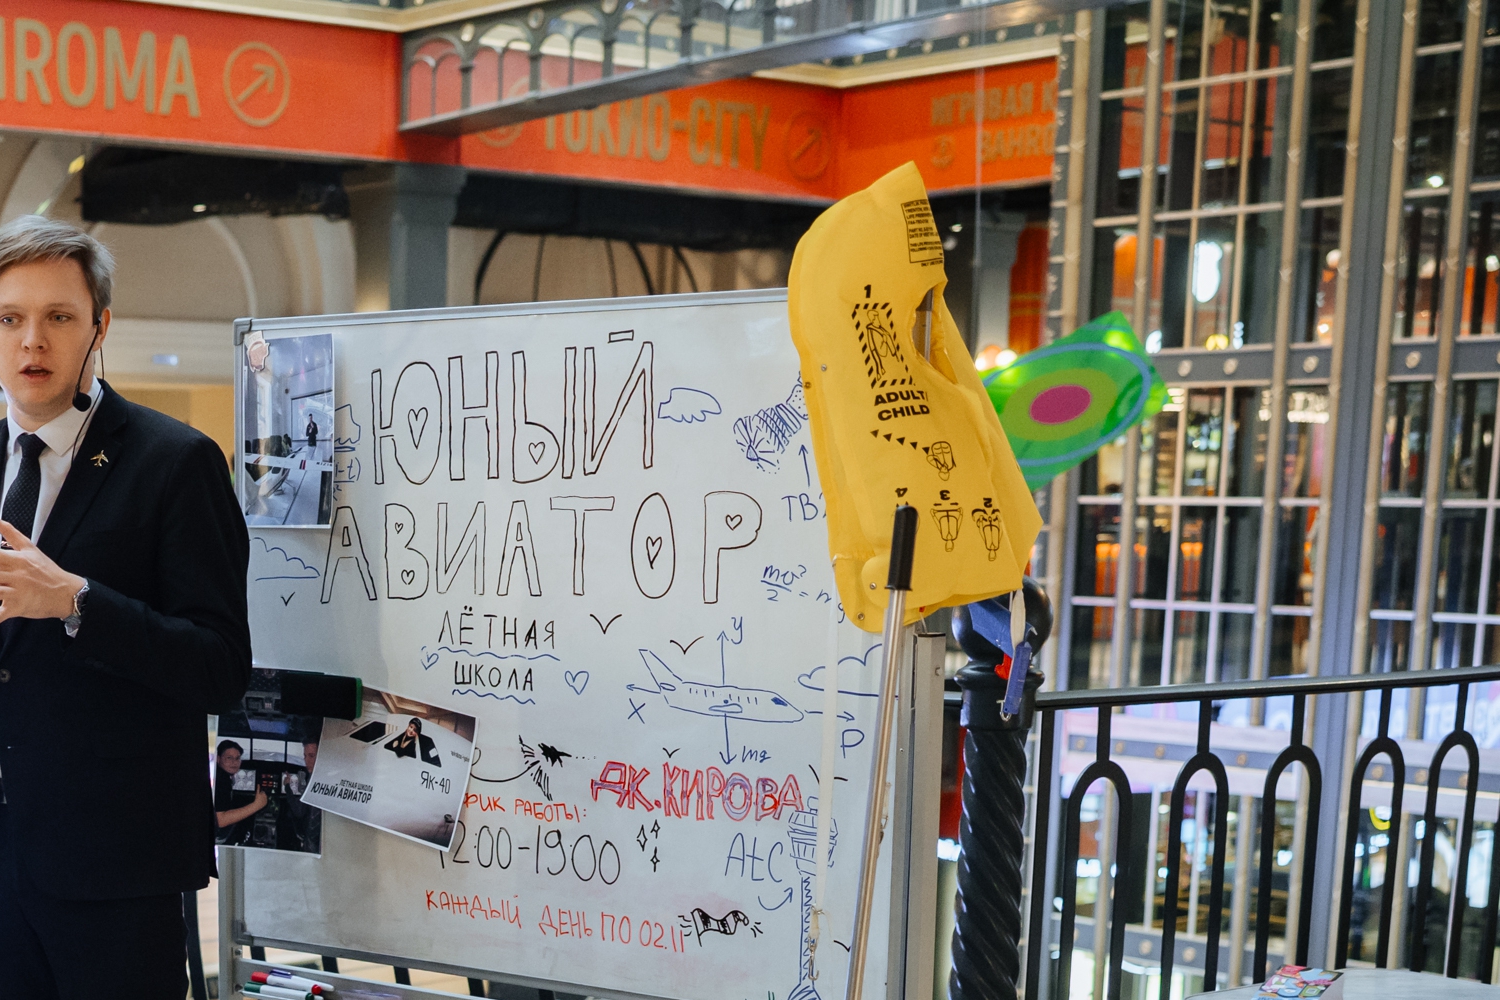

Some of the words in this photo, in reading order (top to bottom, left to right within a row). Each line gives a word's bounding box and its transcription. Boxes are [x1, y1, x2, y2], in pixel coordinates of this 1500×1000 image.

[863, 284, 871, 299] 1
[371, 330, 654, 485] ЮНЫЙ
[878, 405, 930, 421] CHILD
[320, 490, 763, 604] АВИАТОР
[438, 605, 556, 648] ЛЁТНАЯ
[453, 660, 534, 692] ШКОЛА
[310, 781, 339, 798] ЮНЫЙ
[337, 787, 373, 804] АВИАТОР
[425, 889, 522, 929] КАЖДЫЙ
[538, 904, 593, 938] ДЕНЬ
[601, 911, 632, 944] ПО
